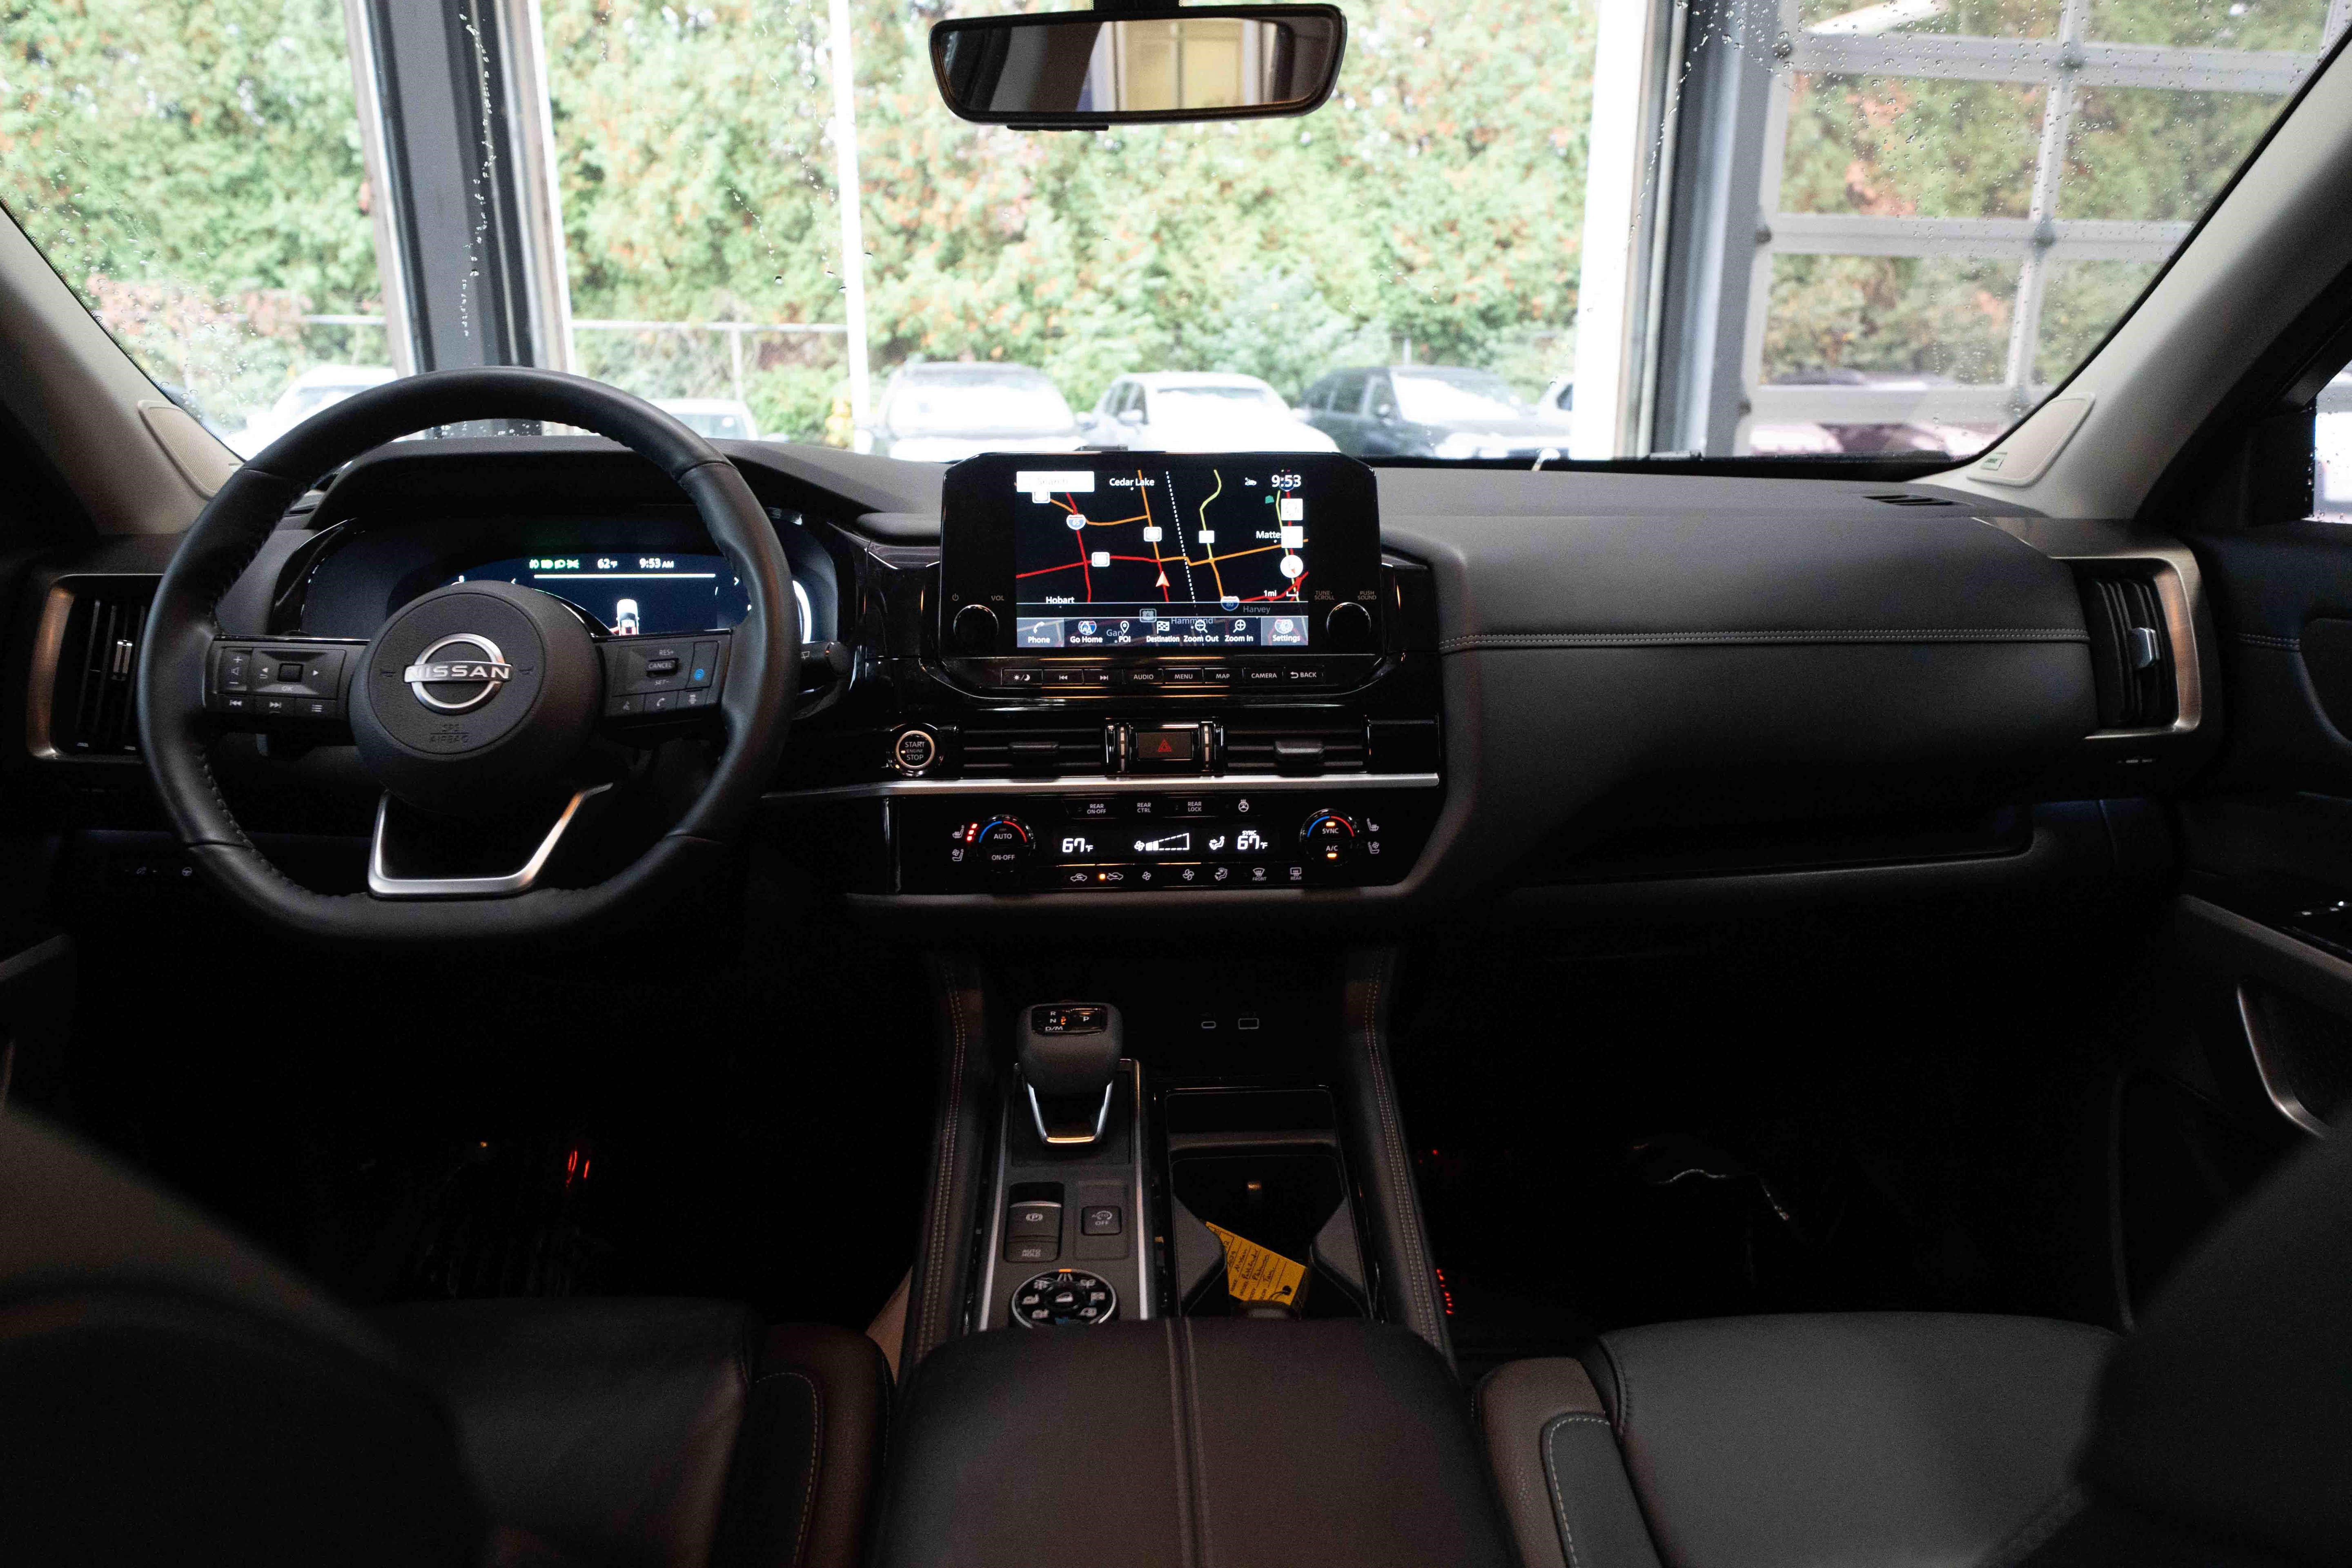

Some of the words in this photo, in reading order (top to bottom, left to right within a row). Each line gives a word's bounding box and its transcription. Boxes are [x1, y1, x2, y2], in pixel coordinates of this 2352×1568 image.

[1109, 478, 1134, 486] Cedar
[1135, 478, 1155, 486] Lake
[1271, 474, 1301, 487] 9:53
[1256, 530, 1281, 539] Matte
[639, 558, 661, 568] 9:53
[1243, 606, 1270, 615] Harvey
[1028, 636, 1050, 644] Phone
[1272, 635, 1301, 644] Settings
[408, 665, 510, 679] NISSAN
